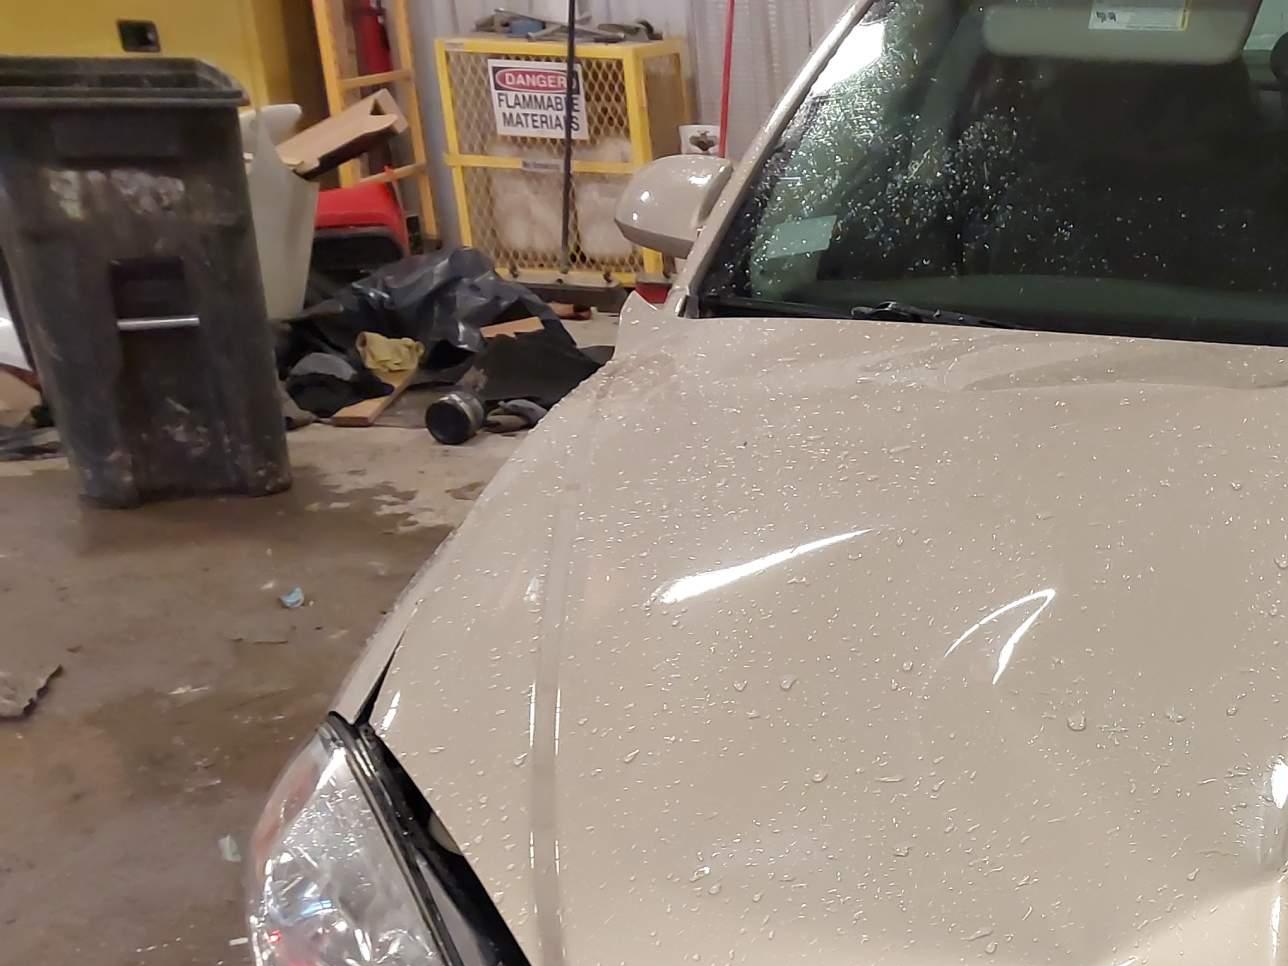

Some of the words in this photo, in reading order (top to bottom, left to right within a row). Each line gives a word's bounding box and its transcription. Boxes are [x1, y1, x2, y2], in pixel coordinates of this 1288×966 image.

[504, 72, 567, 88] DANGER
[497, 92, 580, 113] FLAMMABE
[503, 111, 580, 132] MATERIAS
